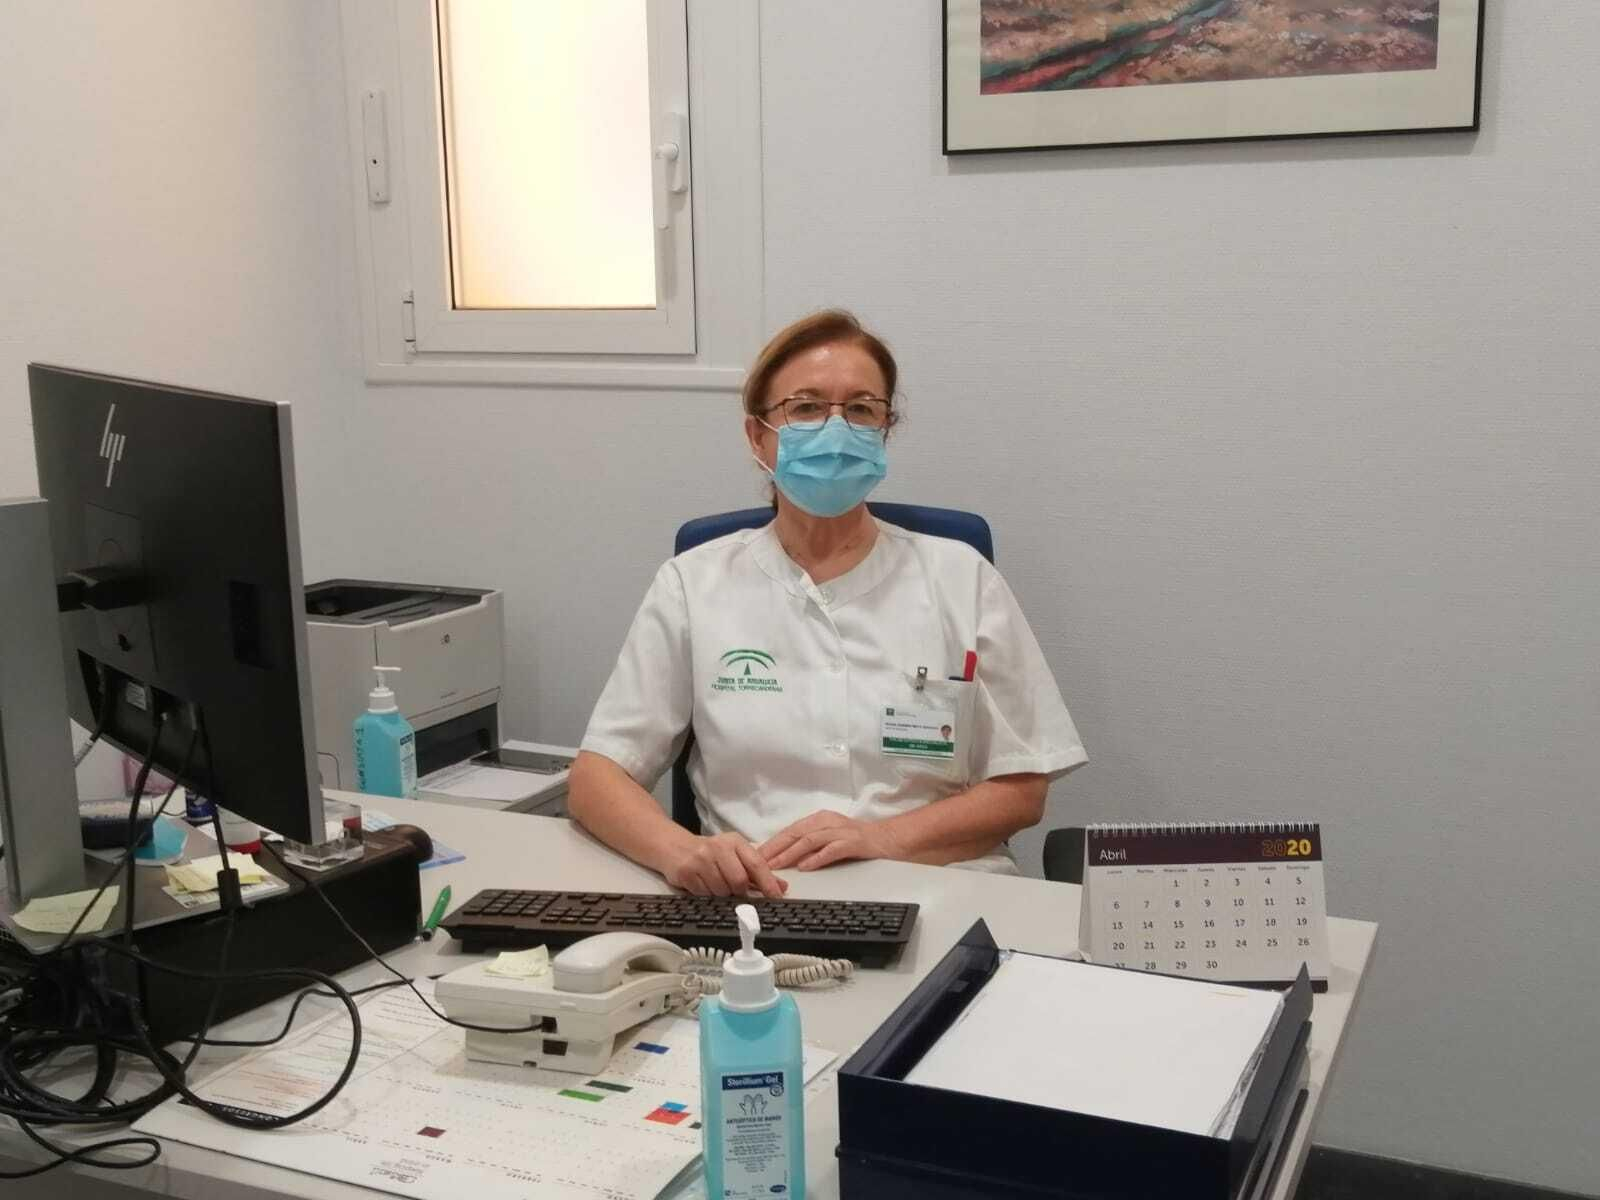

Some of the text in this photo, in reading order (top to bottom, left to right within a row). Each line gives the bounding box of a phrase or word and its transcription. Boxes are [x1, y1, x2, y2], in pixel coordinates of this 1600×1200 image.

[1100, 848, 1127, 861] Abril
[1261, 839, 1312, 857] 2020
[1173, 876, 1303, 888] 1 2 3 4 5
[1113, 896, 1306, 910] 6 7 8 9 10 11 12
[1112, 917, 1308, 930] 13 14 15 16 17 18 19
[1112, 937, 1310, 951] 20 21 22 23 24 25 26
[1144, 961, 1156, 970] 28
[1175, 960, 1188, 970] 29
[1206, 960, 1218, 969] 30
